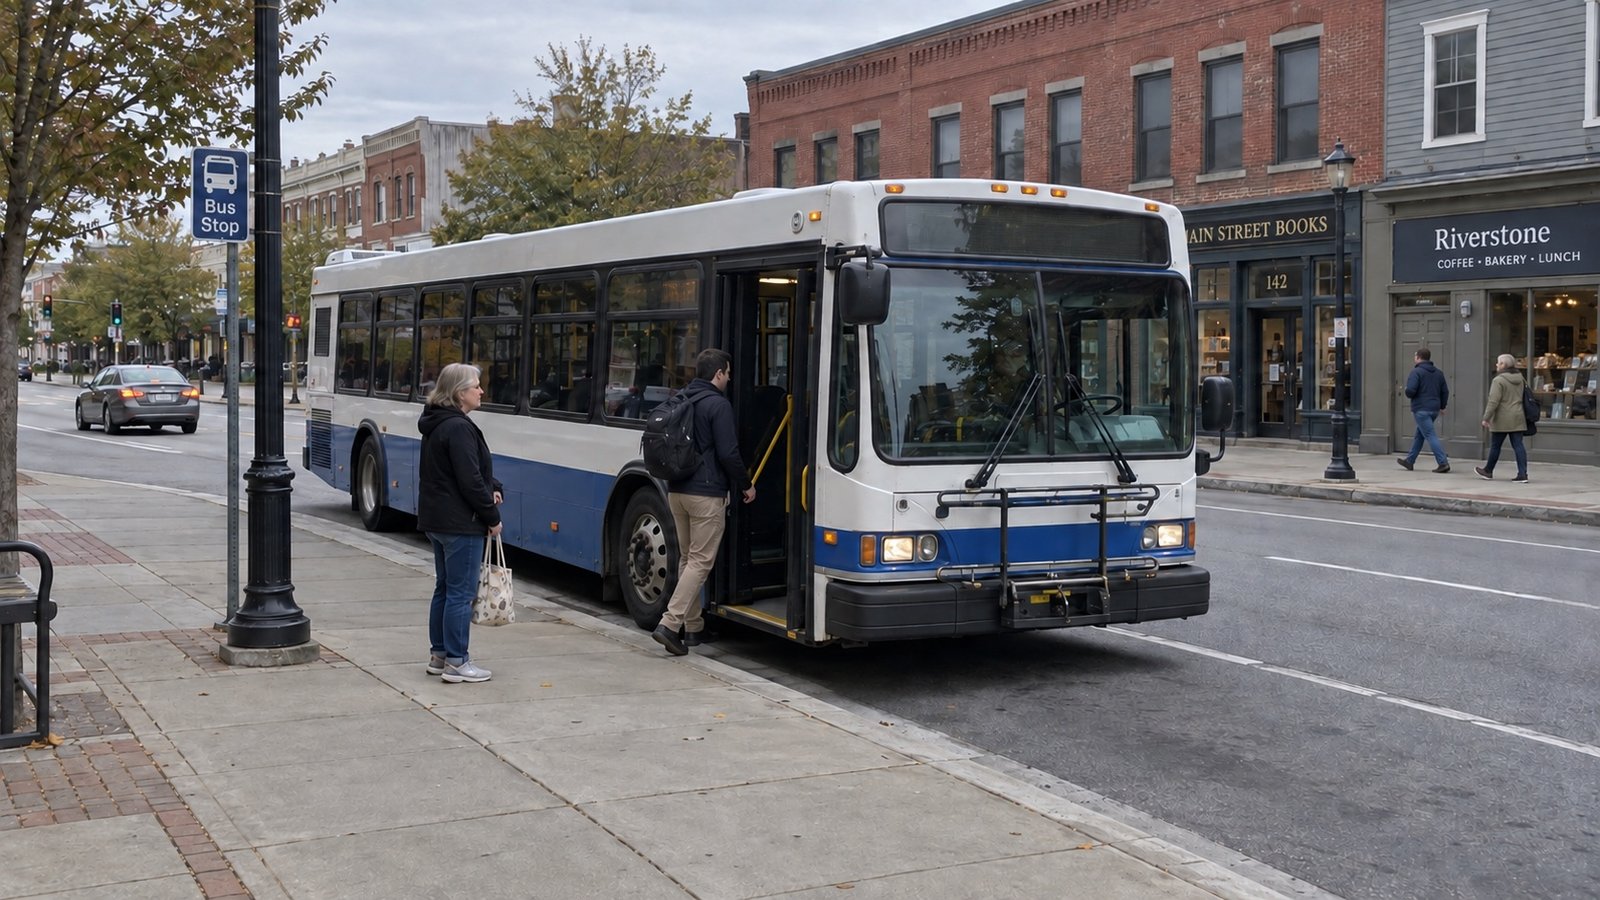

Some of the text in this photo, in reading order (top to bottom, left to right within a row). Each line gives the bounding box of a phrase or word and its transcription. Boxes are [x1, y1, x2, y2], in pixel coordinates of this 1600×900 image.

[205, 199, 236, 214] Bus
[201, 217, 240, 236] Stop
[1186, 216, 1328, 244] AIN STREET BOOKS
[1435, 225, 1550, 250] Riverstone
[1437, 251, 1581, 268] COFFEE BAKERY LUNCH
[1266, 274, 1288, 290] 142
